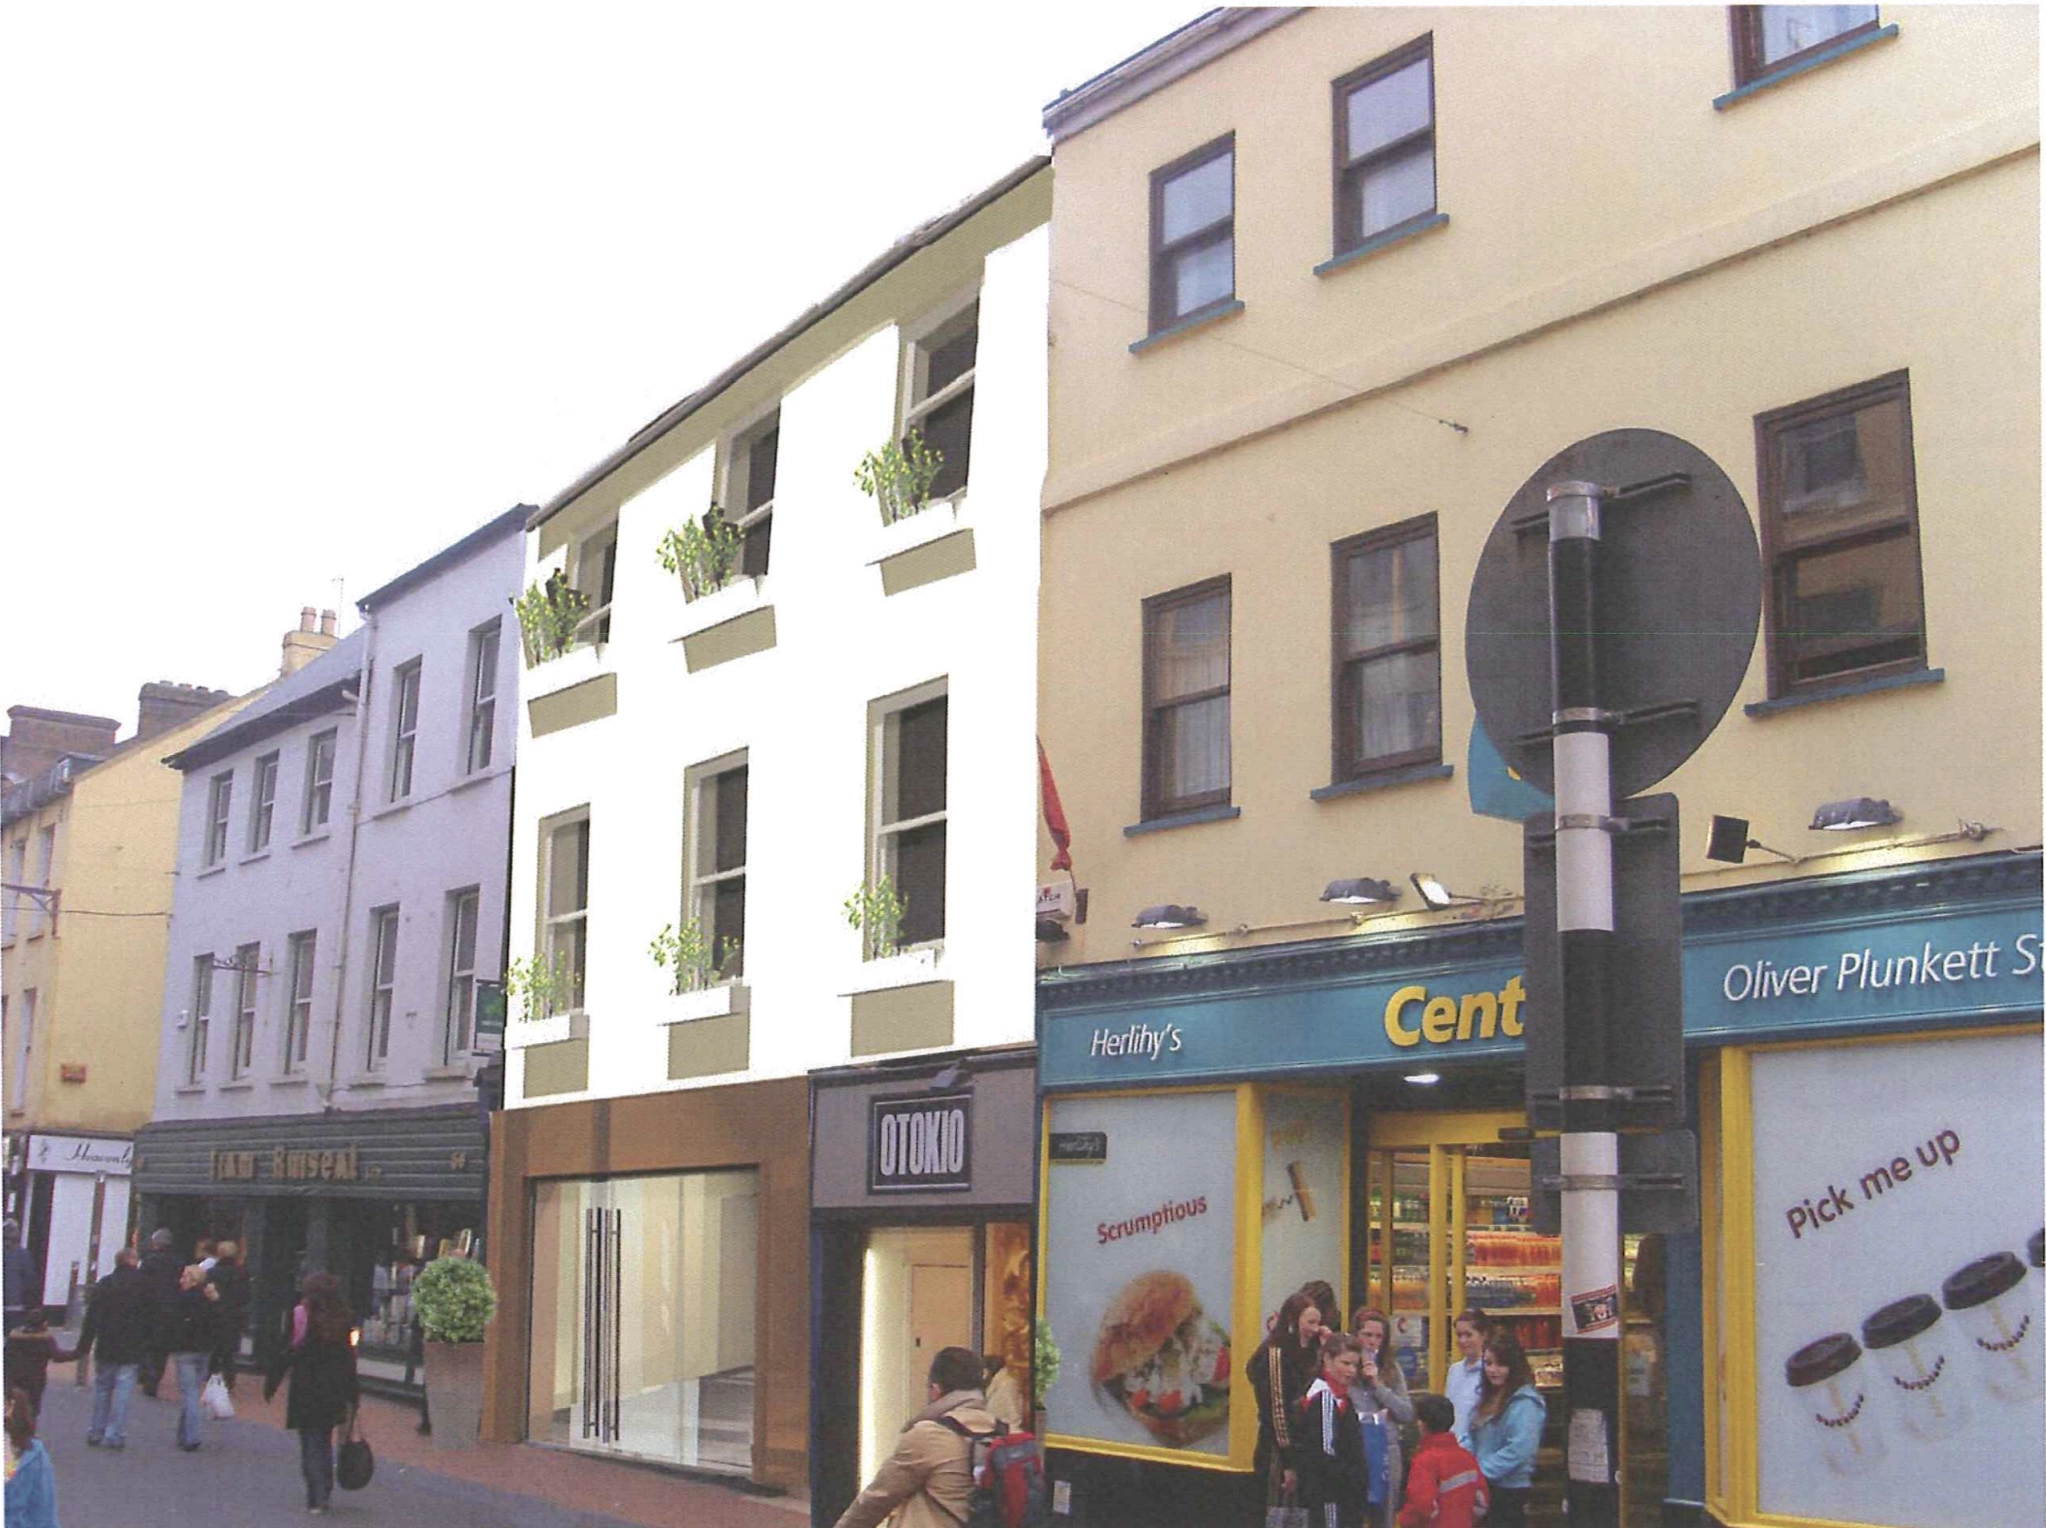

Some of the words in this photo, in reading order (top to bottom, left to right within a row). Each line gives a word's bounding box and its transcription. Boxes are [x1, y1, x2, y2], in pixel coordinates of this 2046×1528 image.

[1724, 960, 1828, 1001] Oliver
[1837, 942, 2001, 991] Plunkett
[1090, 1022, 1182, 1060] Herlihy's
[880, 1109, 965, 1176] OTOKIO
[1786, 1185, 1854, 1239] Pick
[1858, 1156, 1912, 1200] me
[1915, 1129, 1960, 1166] up
[1096, 1197, 1207, 1244] Scrumptious
